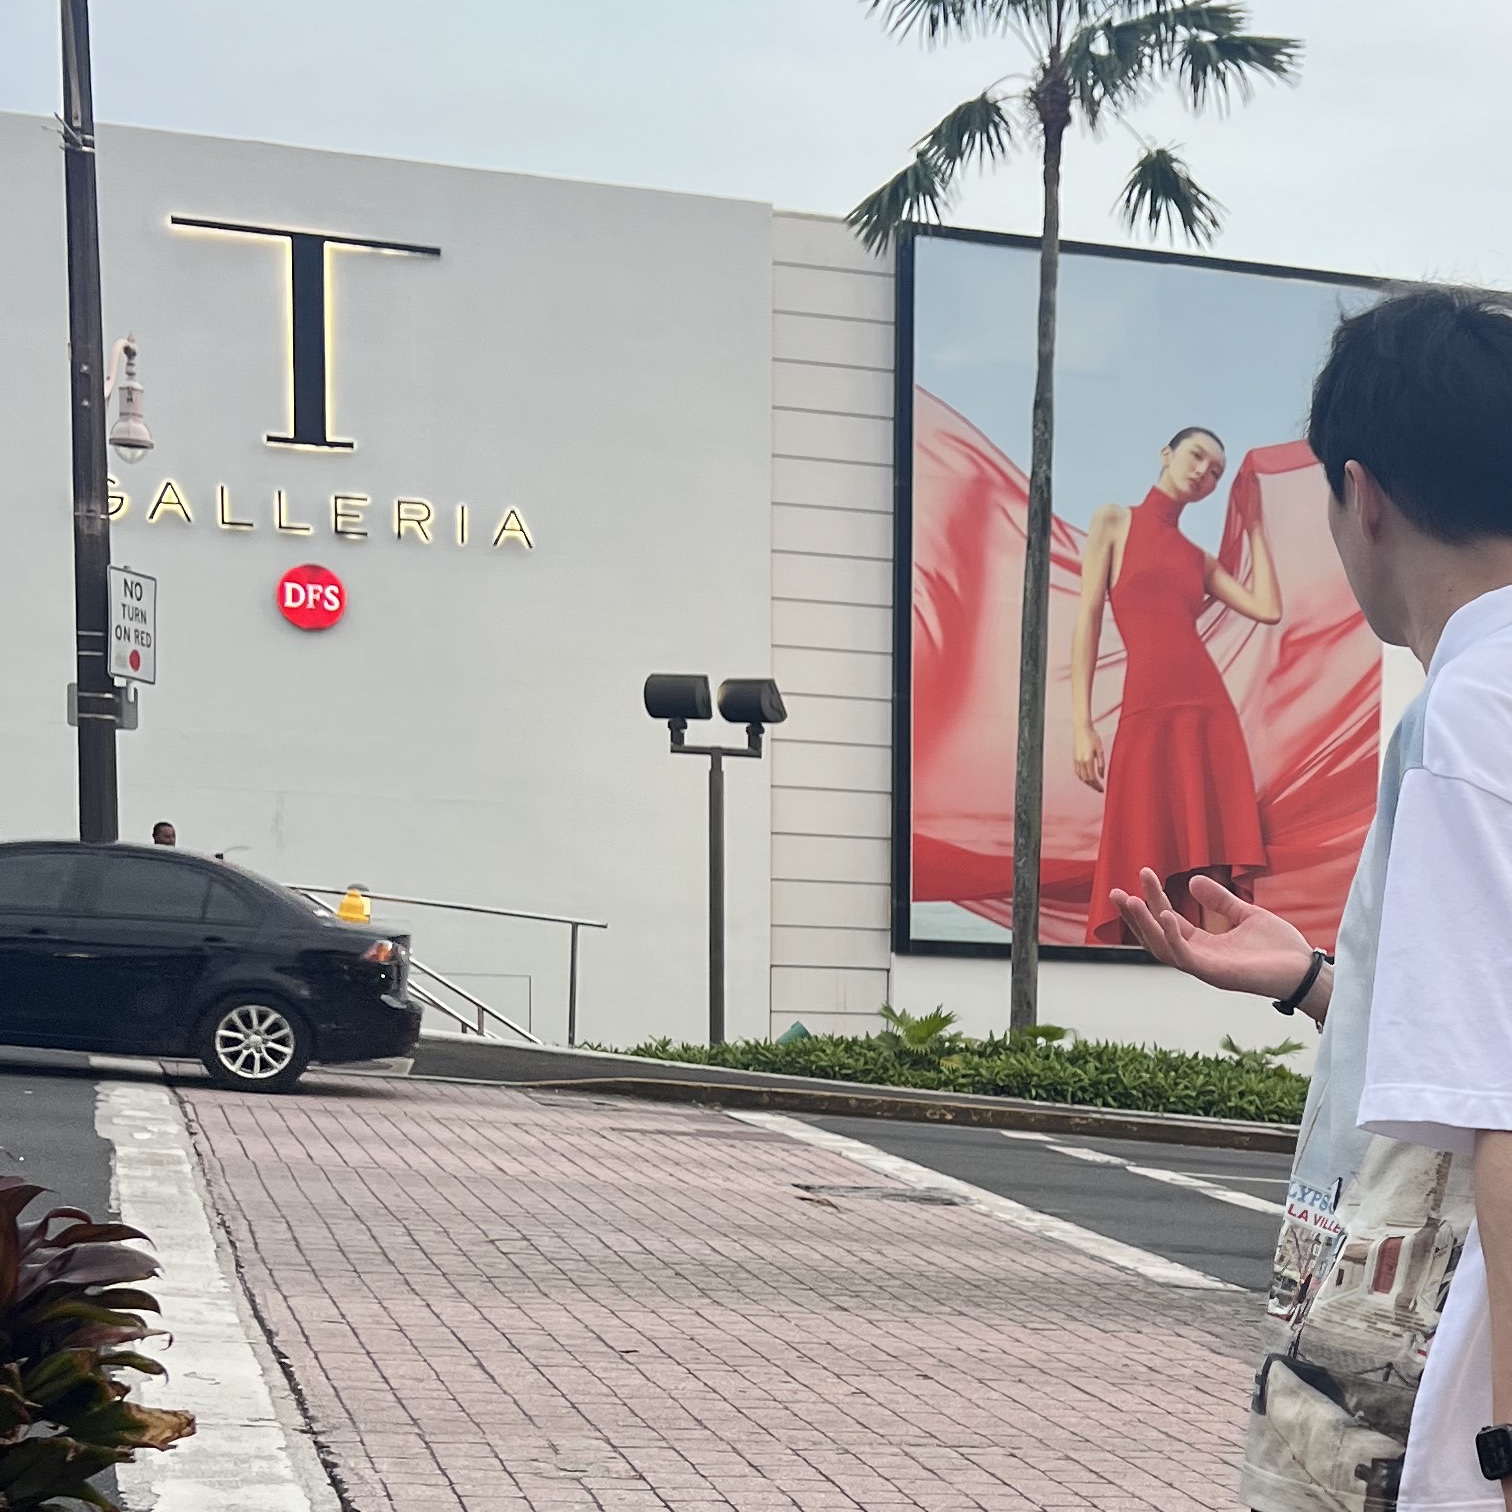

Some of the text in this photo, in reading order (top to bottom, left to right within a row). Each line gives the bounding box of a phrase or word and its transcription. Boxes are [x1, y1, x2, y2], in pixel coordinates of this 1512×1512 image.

[171, 215, 441, 449] T
[123, 578, 143, 601] NO
[283, 581, 341, 612] DFS
[121, 603, 147, 625] TURN
[115, 625, 152, 648] ON RED
[1287, 1203, 1309, 1222] LA
